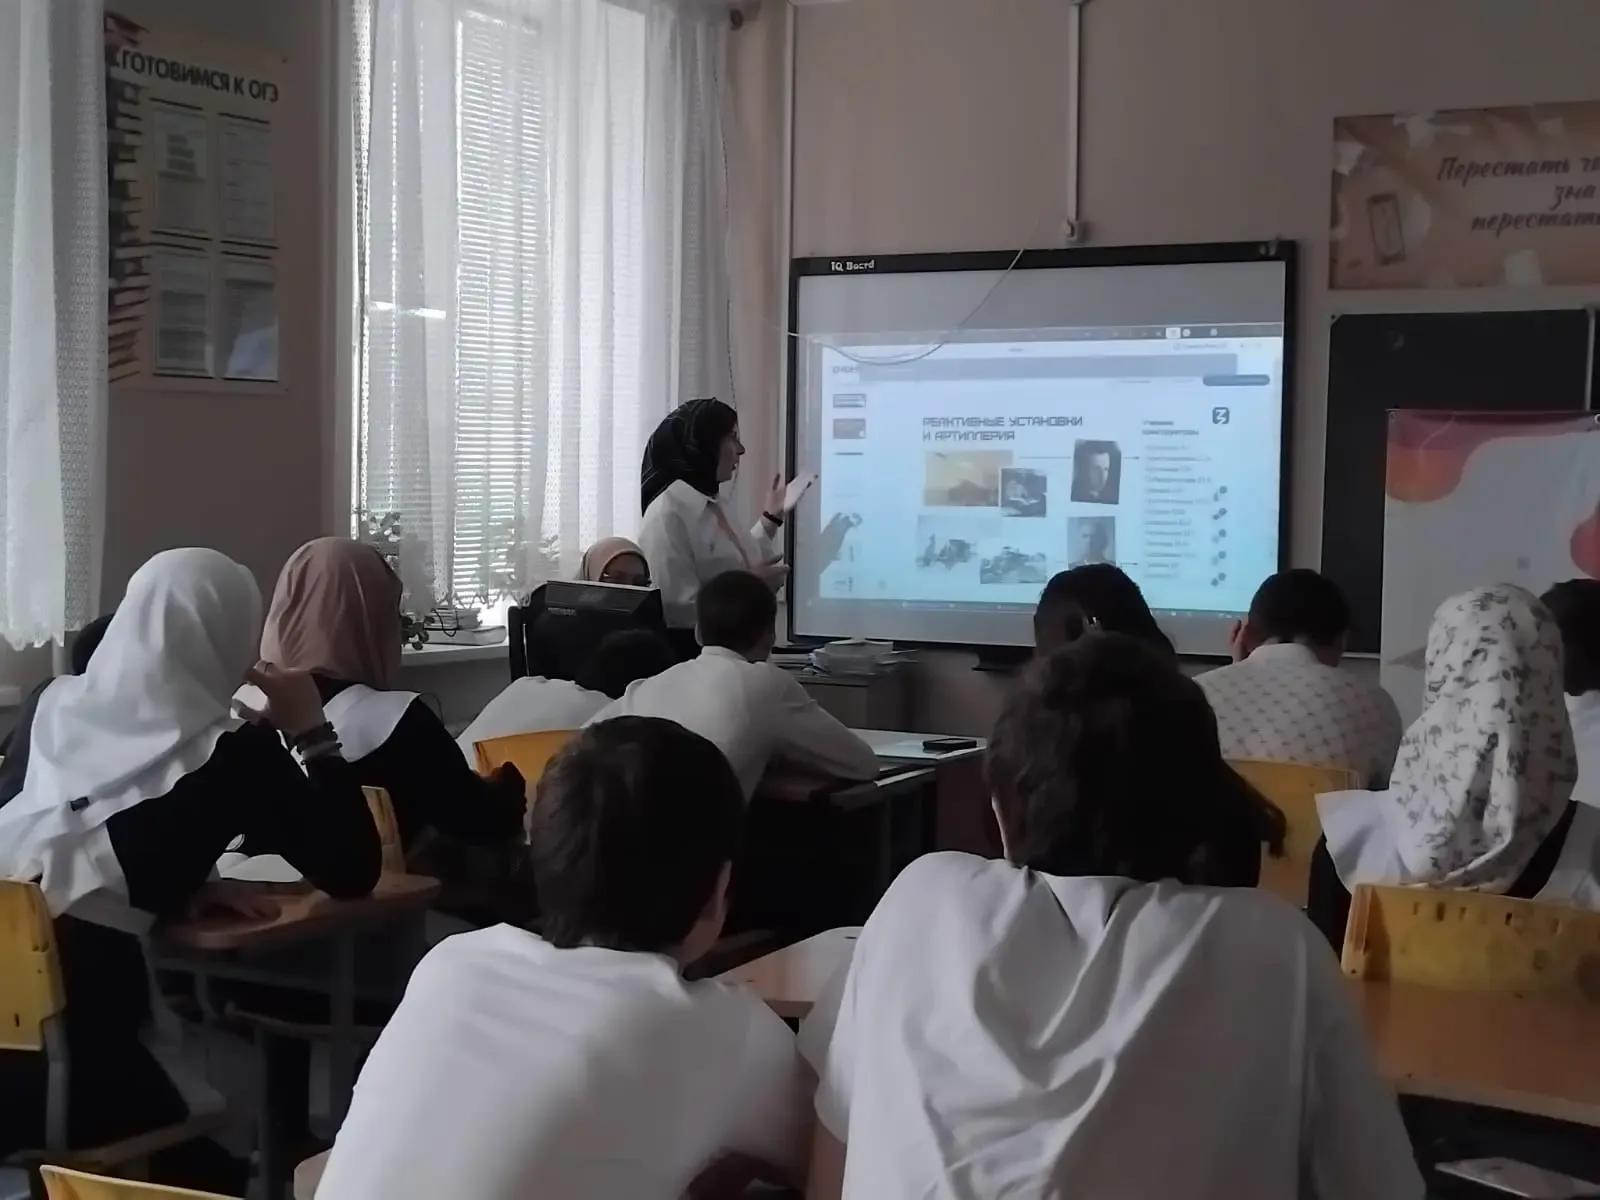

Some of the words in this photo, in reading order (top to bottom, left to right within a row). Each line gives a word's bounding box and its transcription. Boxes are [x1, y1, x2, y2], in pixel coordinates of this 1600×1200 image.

[122, 50, 230, 93] ГОТОВИМСЯ
[234, 76, 244, 95] К
[1437, 154, 1570, 188] Перестать
[831, 261, 844, 272] IQ
[846, 259, 875, 271] Board
[922, 416, 1005, 428] РЕАКТИВНЫЕ
[1008, 415, 1083, 427] УСТАНОВКИ
[922, 430, 931, 442] И
[935, 430, 1016, 441] АРТИЛЛЕРИЯ
